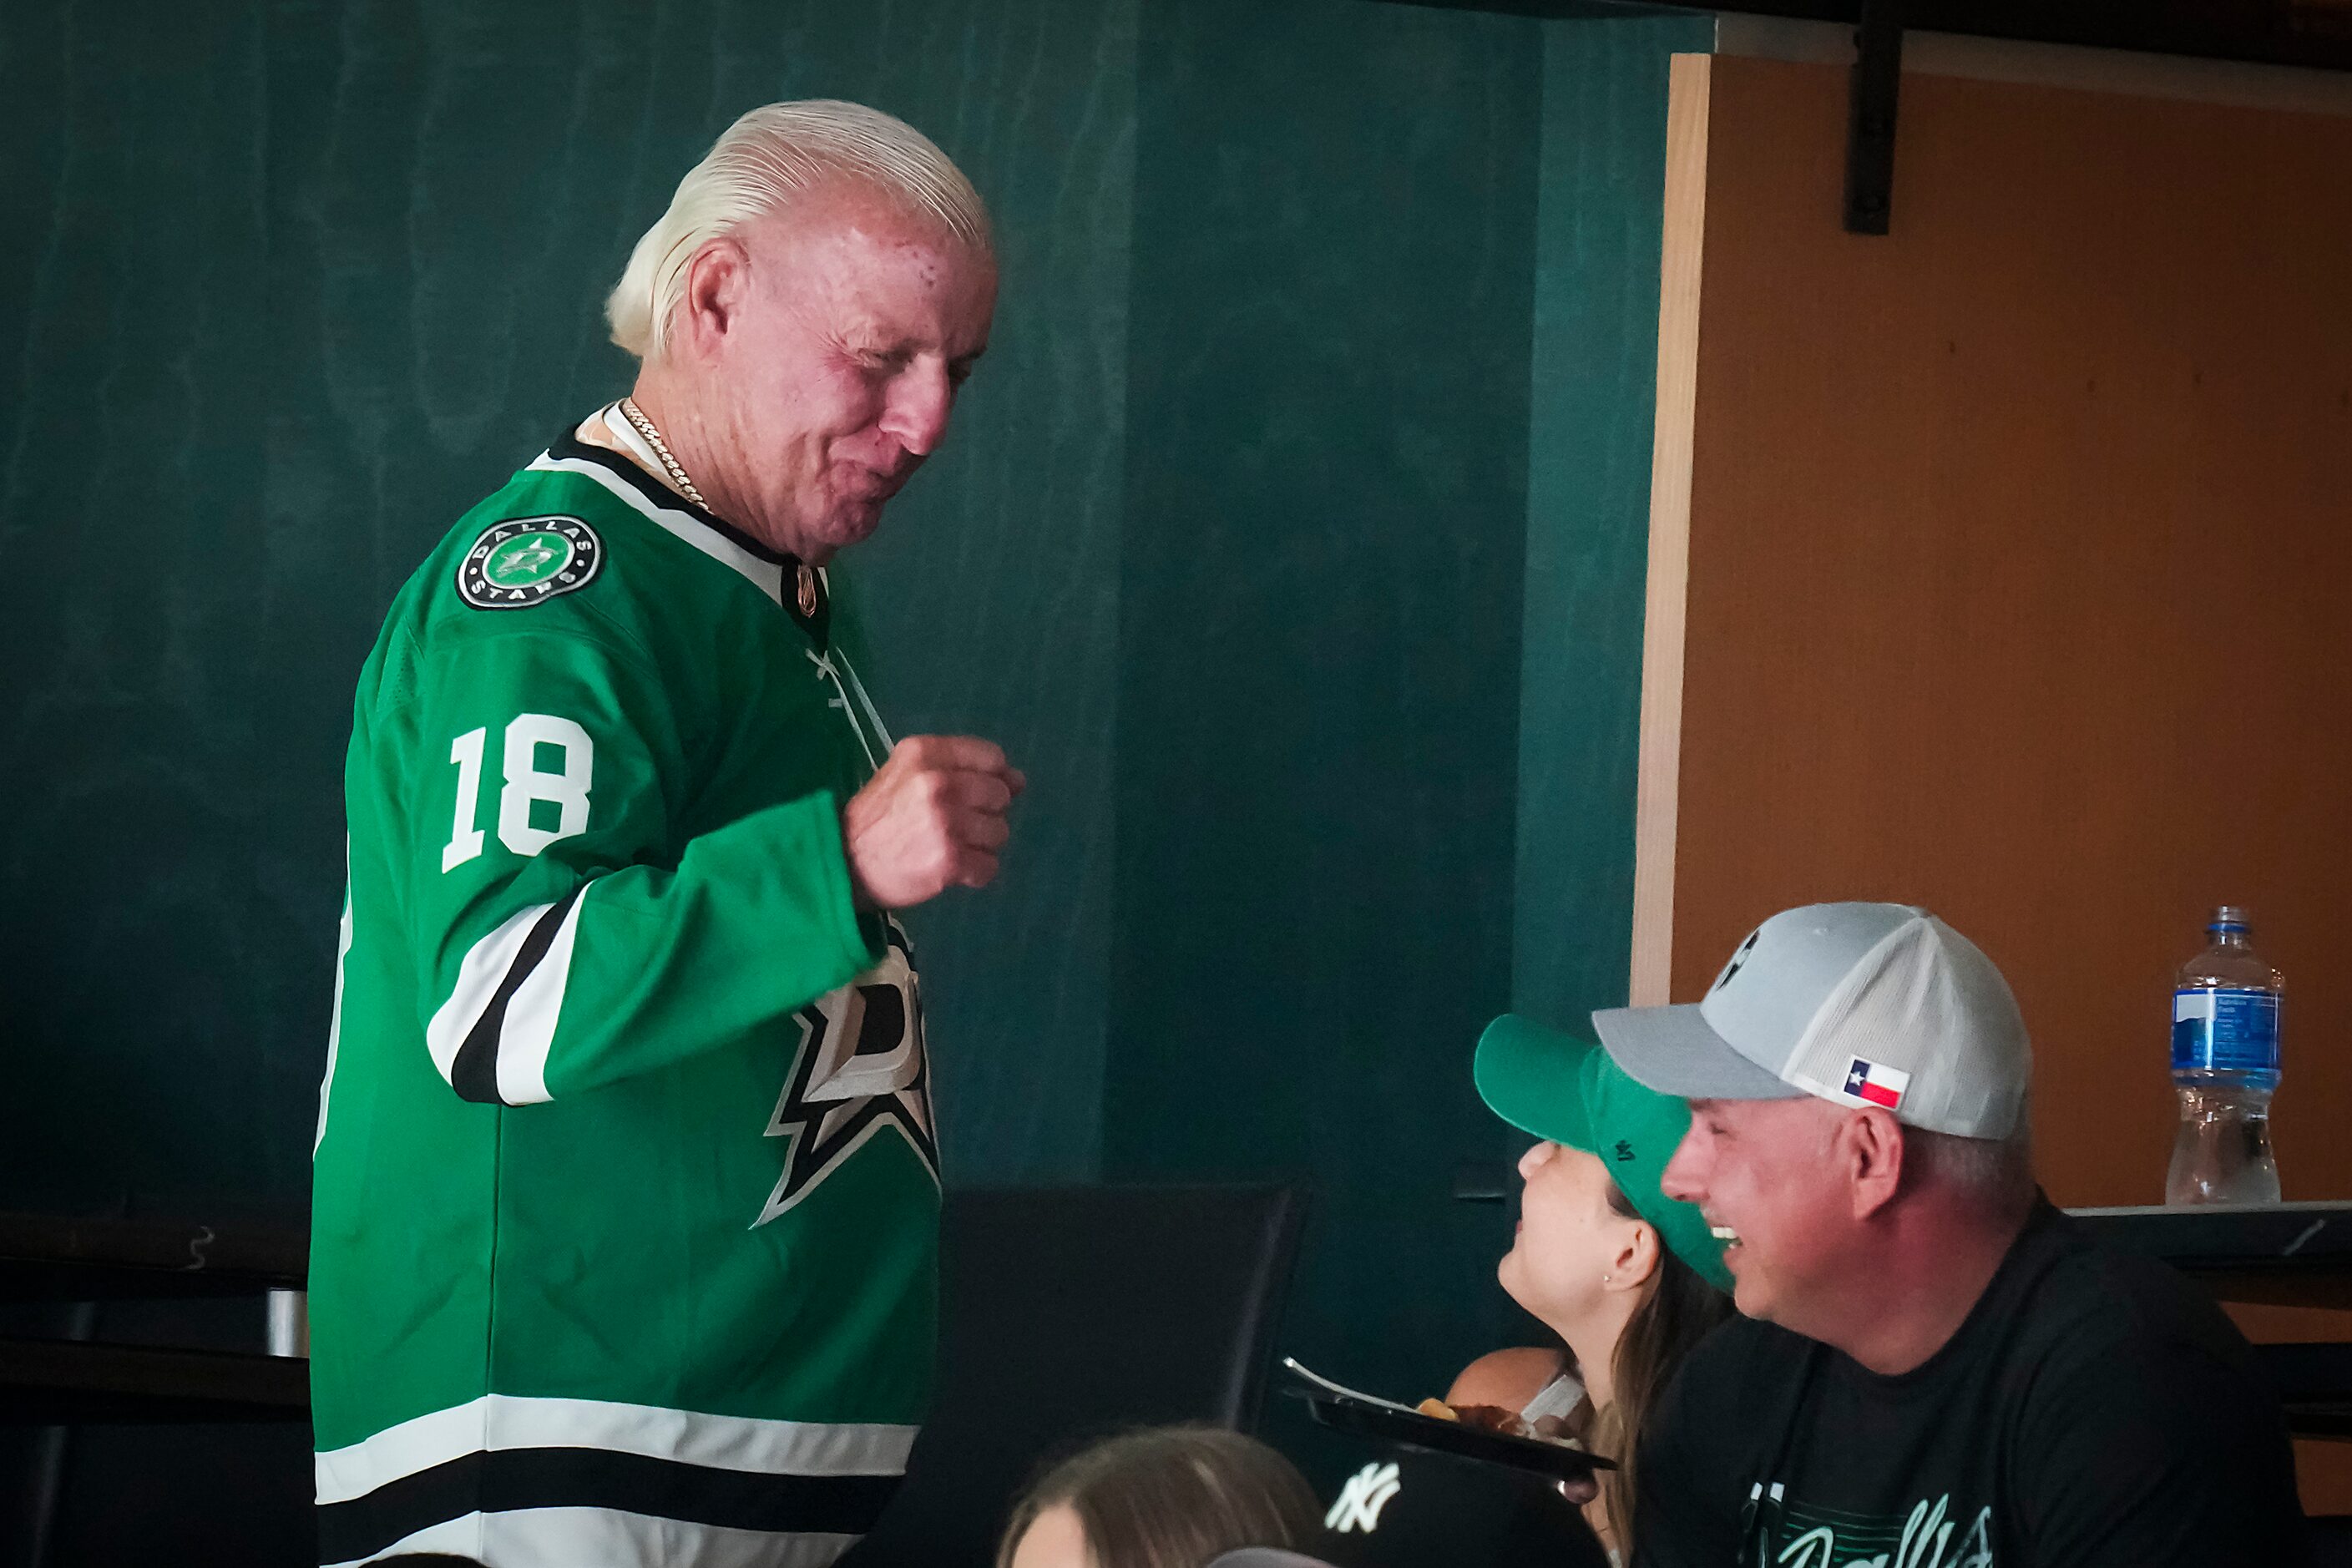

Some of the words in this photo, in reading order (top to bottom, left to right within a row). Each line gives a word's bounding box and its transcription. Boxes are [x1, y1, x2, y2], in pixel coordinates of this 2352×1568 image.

[472, 520, 592, 559] DALLAS
[470, 571, 576, 599] STARS
[441, 712, 594, 874] 18
[1324, 1462, 1401, 1534] NY
